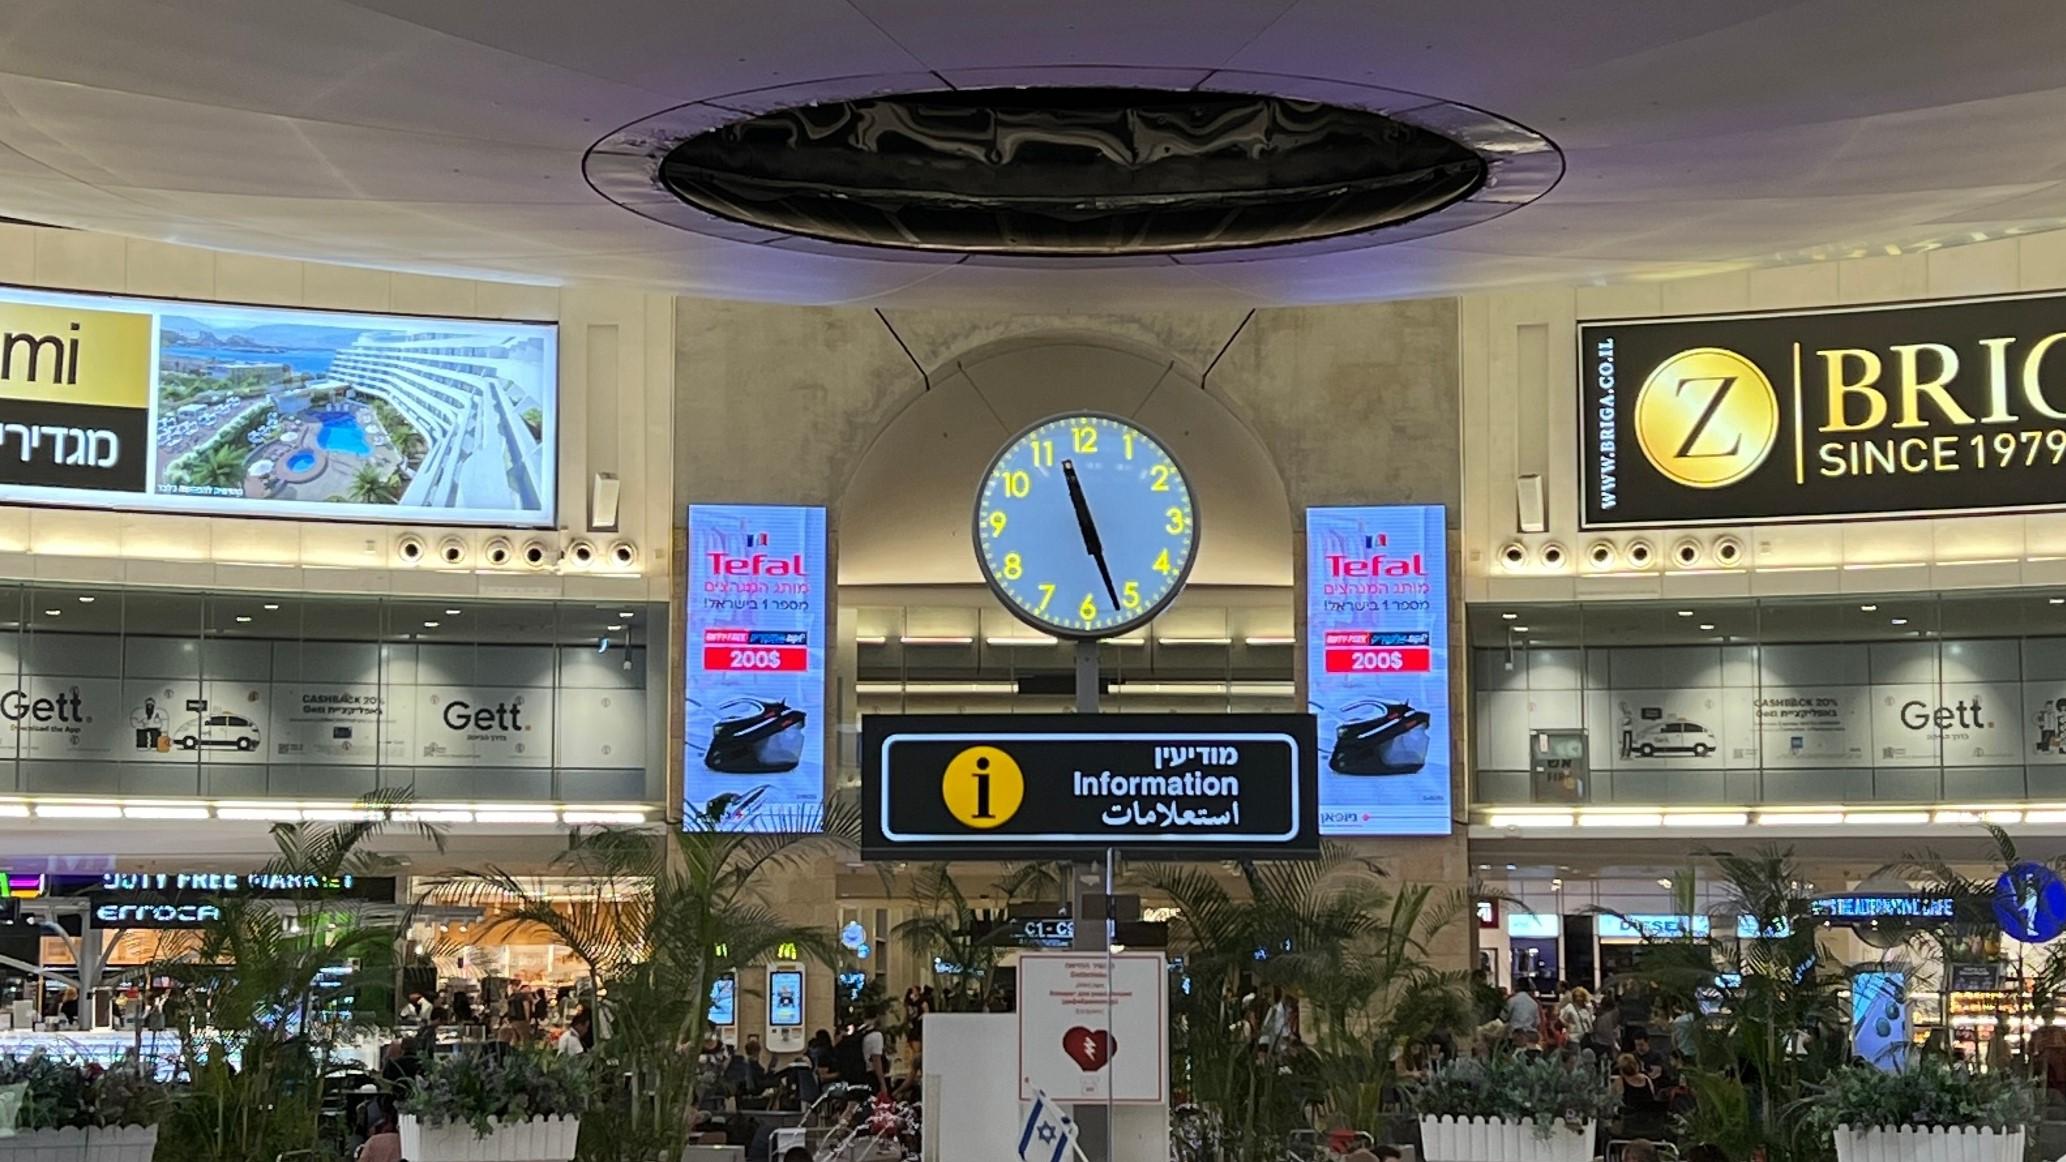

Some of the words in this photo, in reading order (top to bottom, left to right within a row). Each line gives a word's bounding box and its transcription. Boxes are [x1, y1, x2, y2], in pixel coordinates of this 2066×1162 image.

[1599, 337, 1616, 511] WWW.BRIGA.CO.IL
[1673, 376, 1742, 458] Z
[1072, 427, 1098, 453] 12
[1123, 433, 1133, 460] 1
[1031, 441, 1053, 467] 11
[1819, 436, 1960, 478] SINCE
[1970, 430, 2066, 470] 1979
[1002, 471, 1030, 498] 10
[1151, 465, 1169, 491] 2
[989, 511, 1007, 538] 9
[1166, 508, 1184, 535] 3
[705, 552, 809, 577] Tefal
[1004, 553, 1022, 580] 8
[1153, 548, 1170, 575] 4
[1325, 554, 1429, 577] Tefal
[772, 599, 809, 610] מספר
[1038, 584, 1056, 610] 7
[1080, 594, 1096, 620] 6
[1123, 582, 1139, 608] 5
[1392, 600, 1430, 611] מספר
[730, 651, 781, 669] 200$
[1352, 652, 1403, 670] 200$
[1154, 746, 1239, 770] מודיעין
[1073, 771, 1239, 796] Information
[1102, 801, 1240, 827] استعلامات
[1025, 922, 1043, 938] C1
